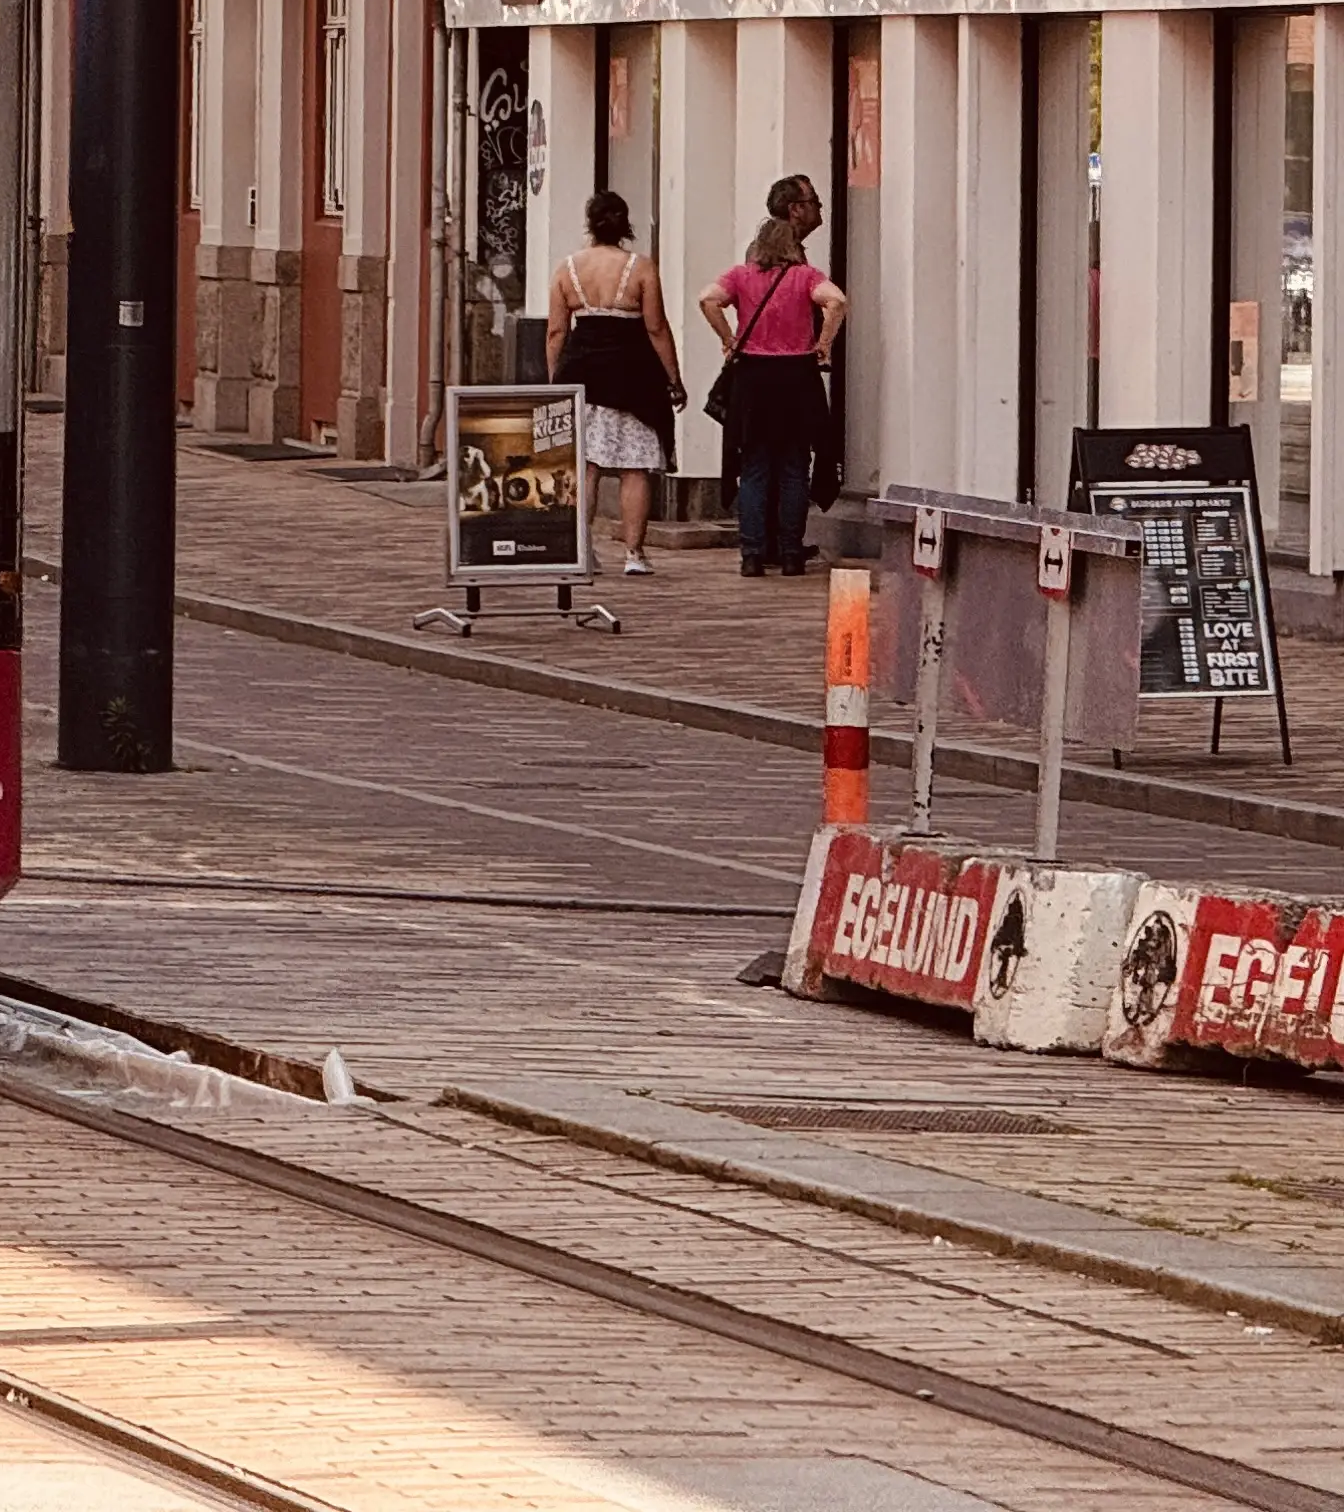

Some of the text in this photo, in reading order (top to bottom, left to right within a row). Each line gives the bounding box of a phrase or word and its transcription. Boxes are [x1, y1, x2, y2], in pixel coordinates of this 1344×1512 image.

[533, 414, 573, 439] KILLS
[1203, 622, 1255, 638] LOVE
[1220, 639, 1240, 651] AT
[1206, 652, 1260, 668] FIRST
[1209, 669, 1261, 686] BITE
[833, 873, 980, 983] EGELUND
[1193, 933, 1344, 1045] EGEL
